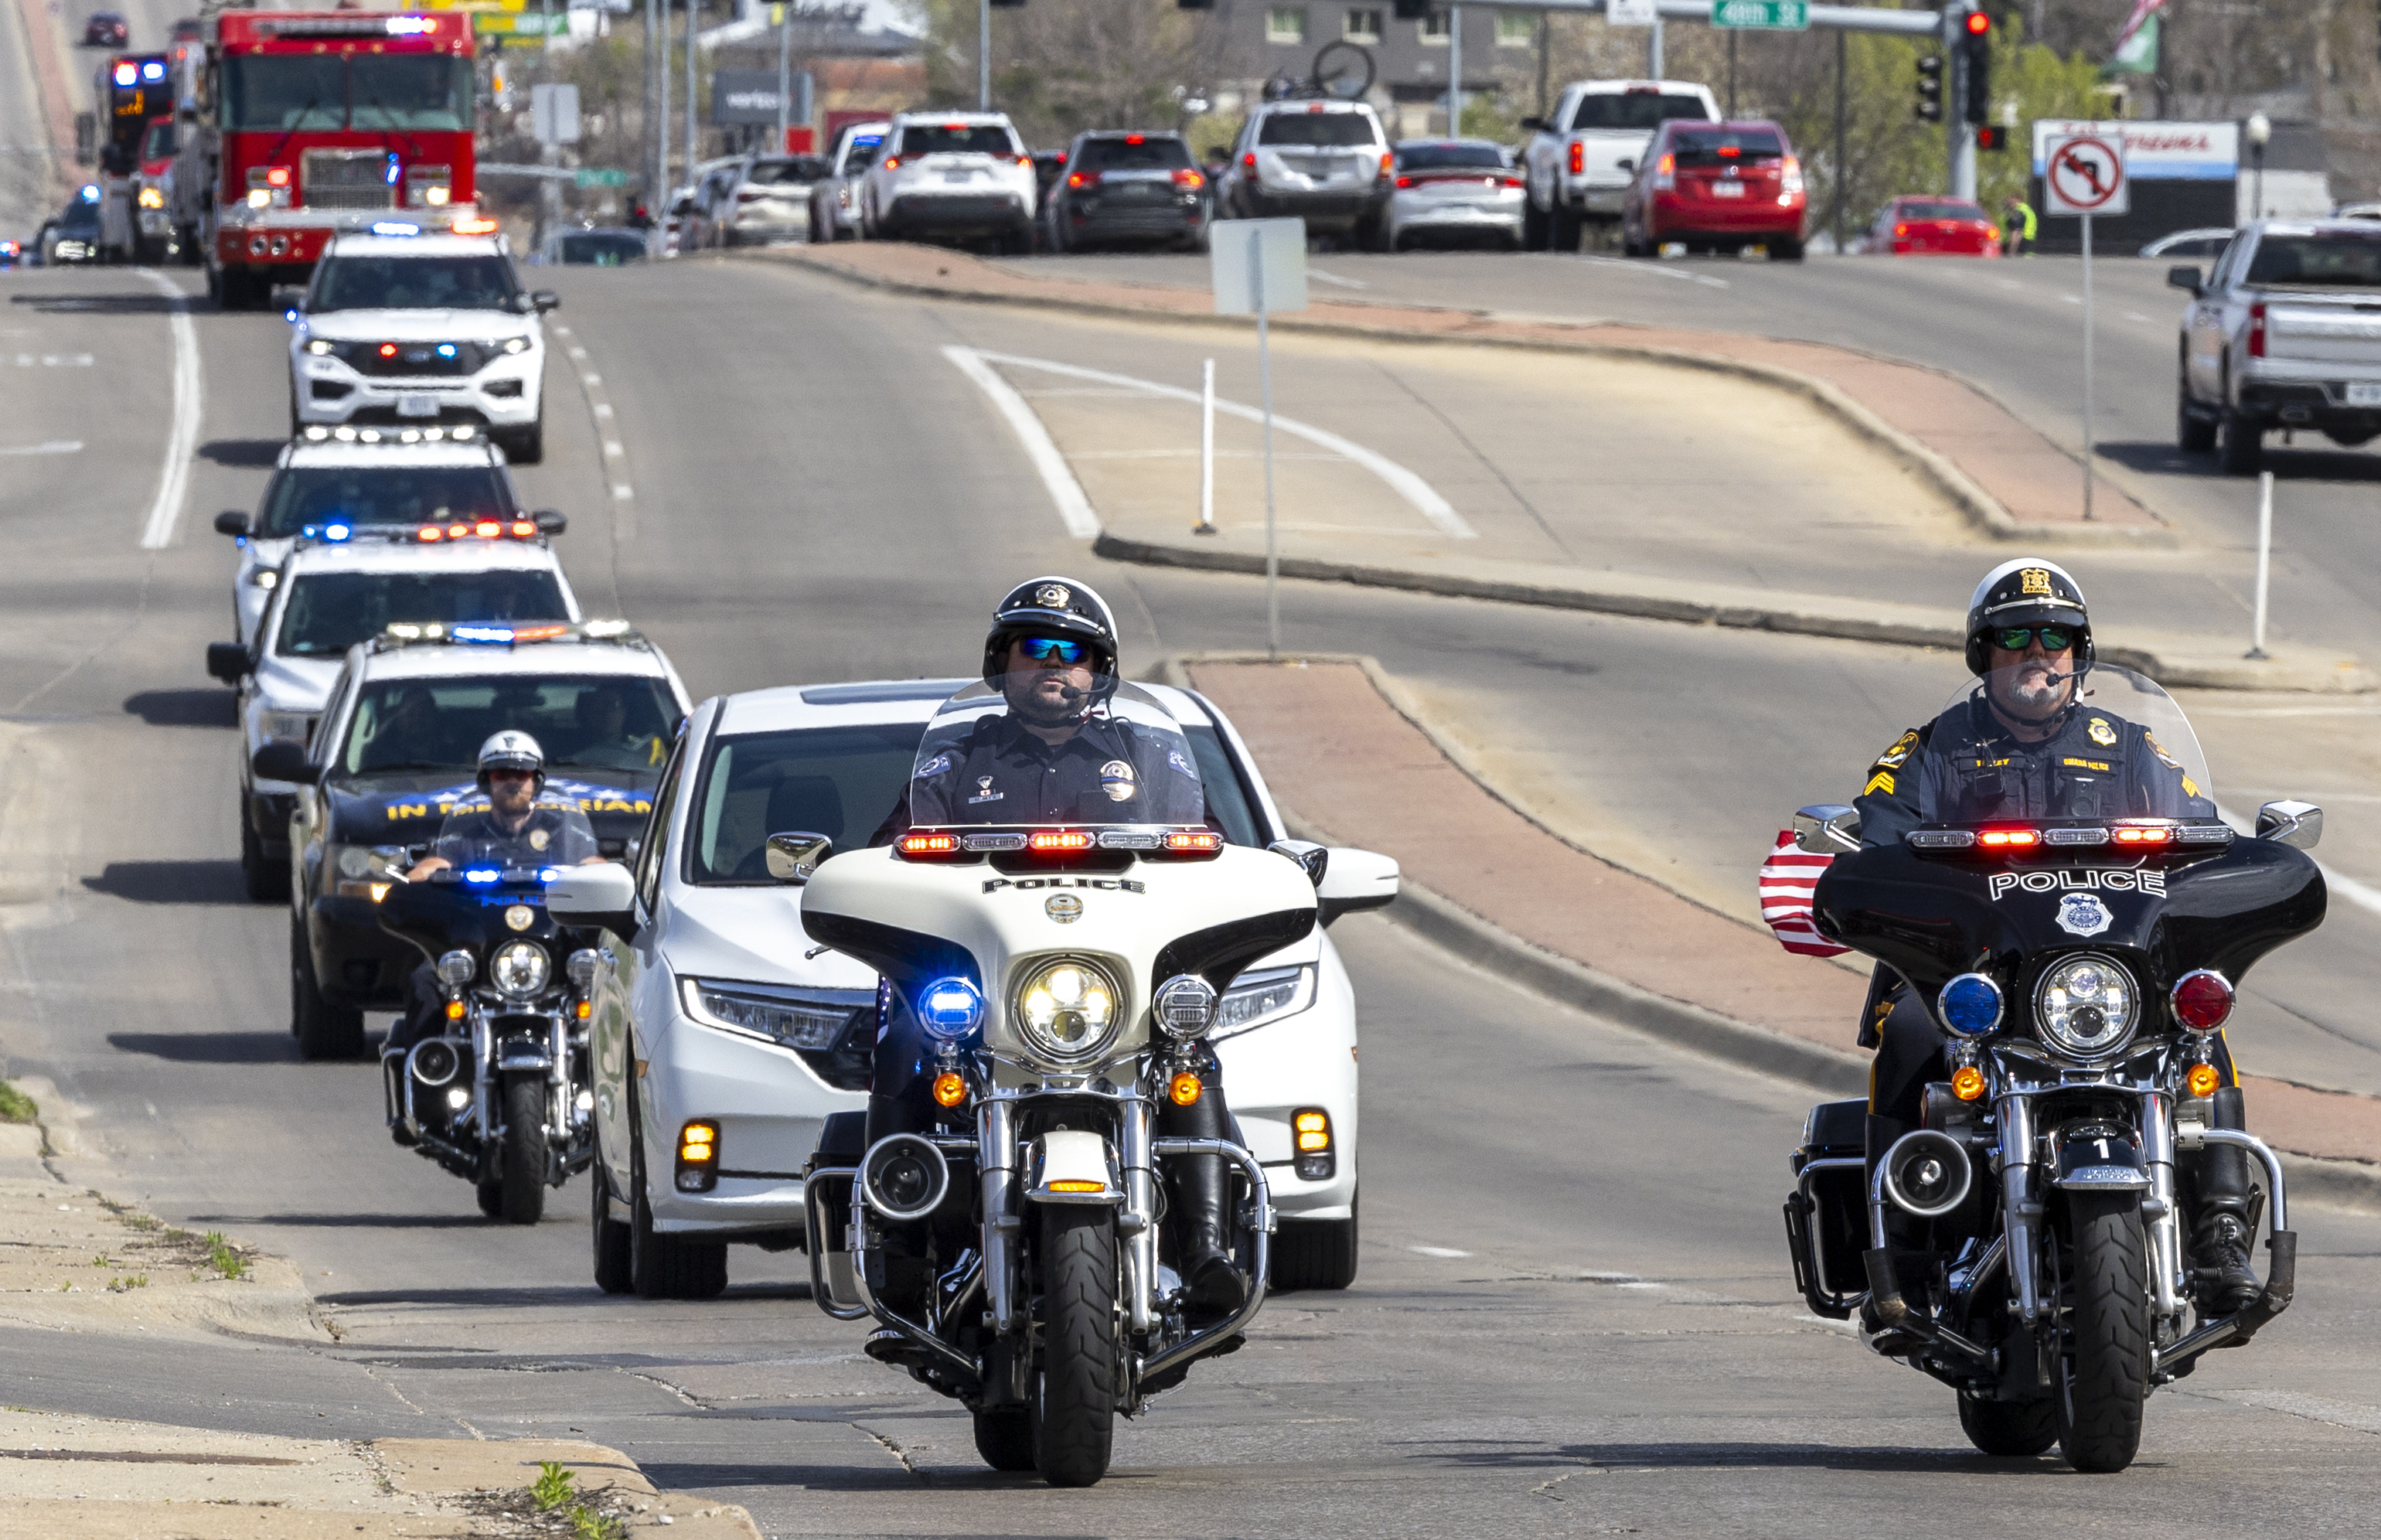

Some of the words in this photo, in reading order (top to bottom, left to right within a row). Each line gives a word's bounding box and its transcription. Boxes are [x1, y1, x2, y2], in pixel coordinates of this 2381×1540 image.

[2087, 761, 2110, 772] POLICE
[387, 803, 427, 820] IN
[983, 877, 1146, 894] POLICE
[1988, 869, 2167, 901] POLICE
[2093, 1138, 2110, 1159] 1
